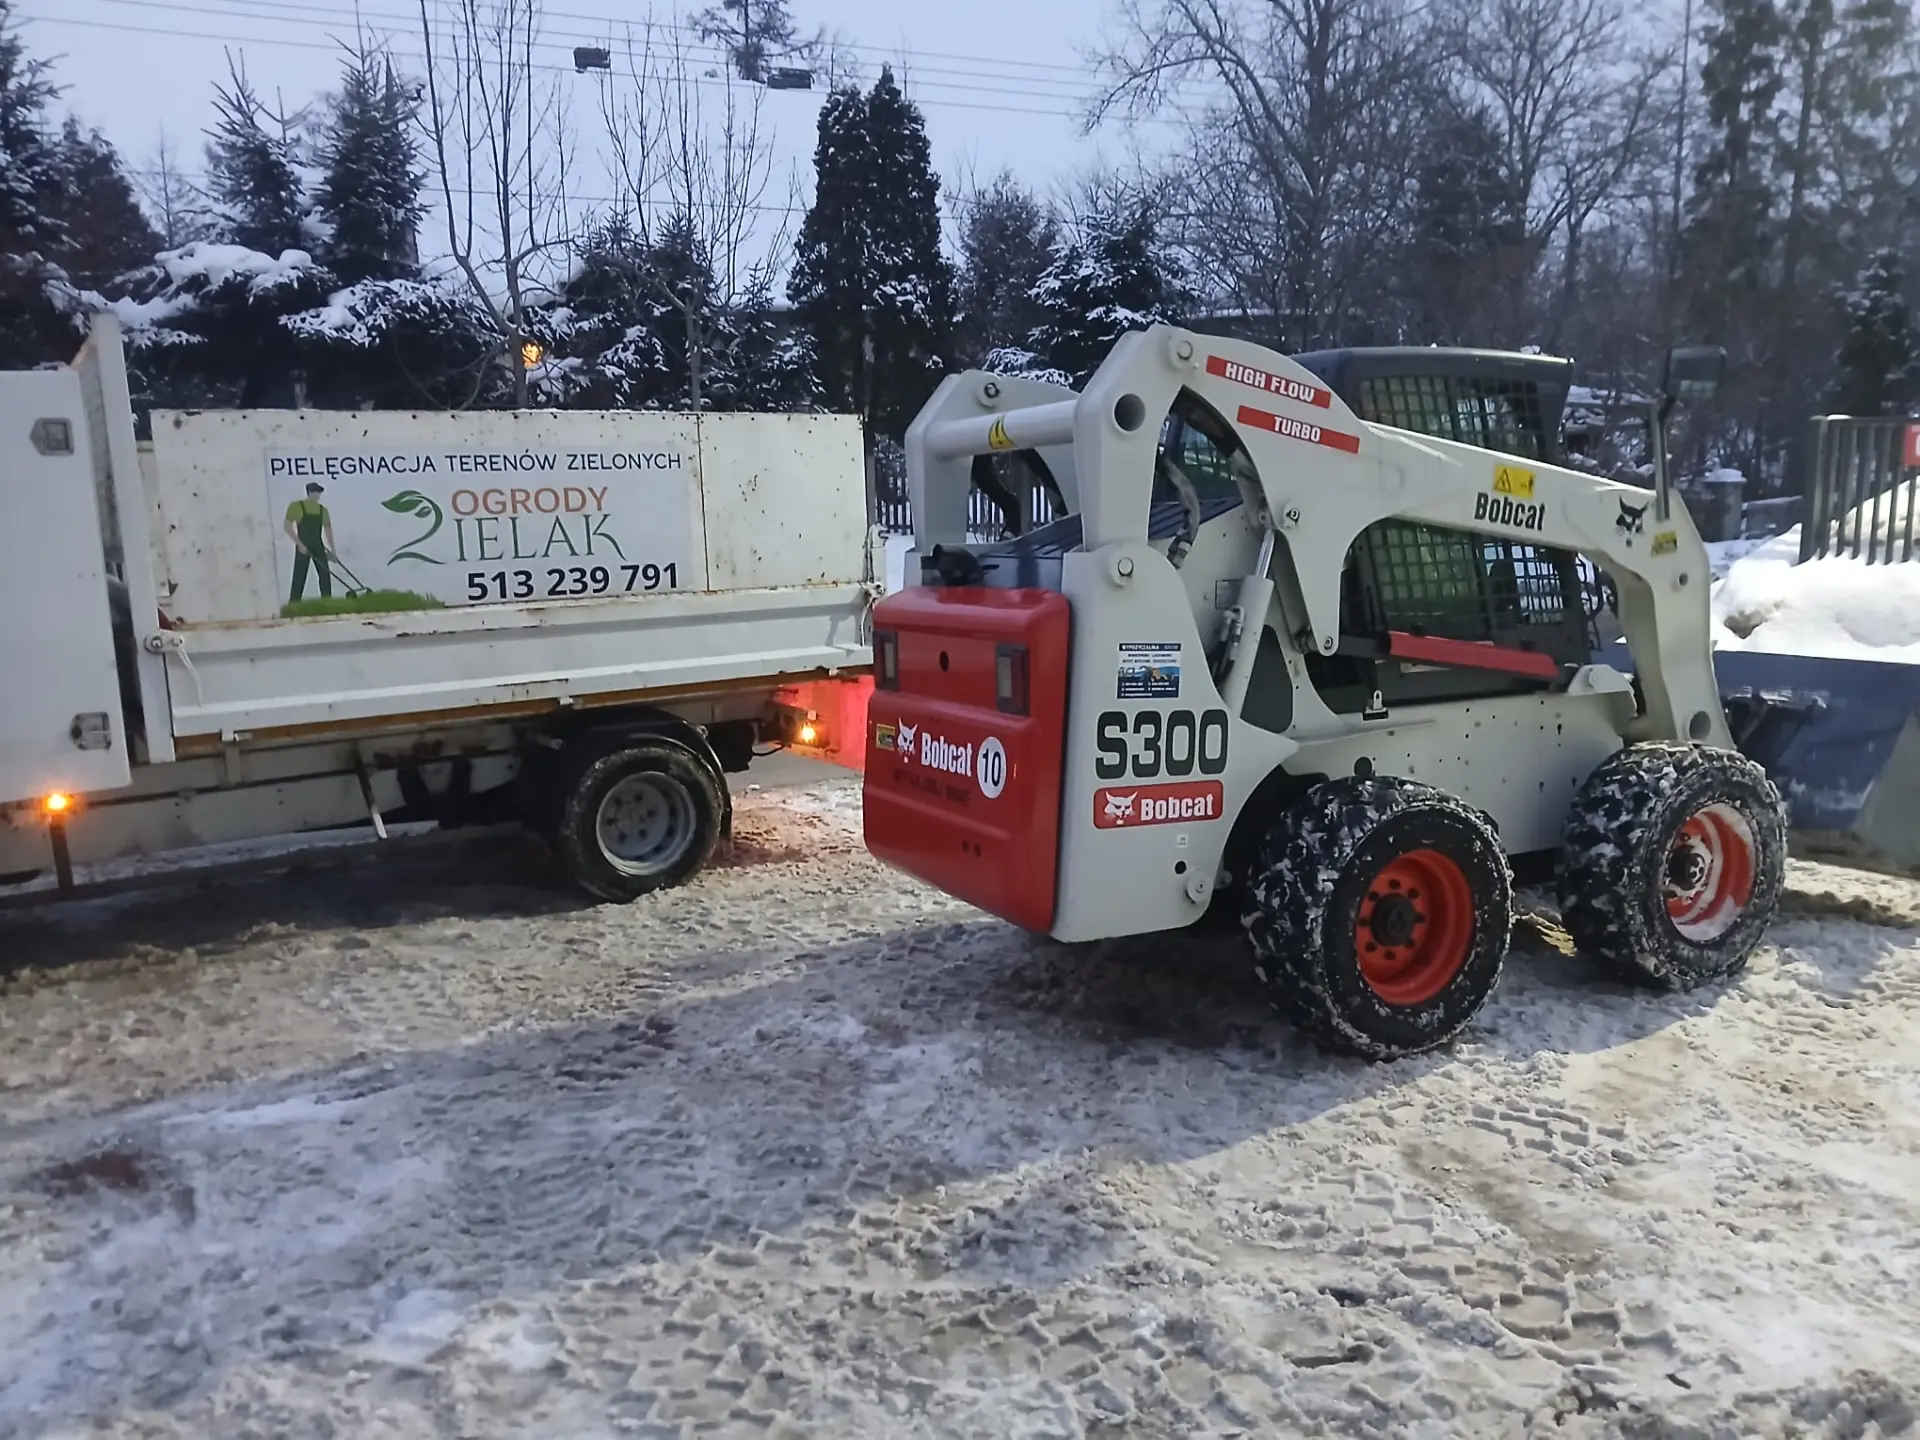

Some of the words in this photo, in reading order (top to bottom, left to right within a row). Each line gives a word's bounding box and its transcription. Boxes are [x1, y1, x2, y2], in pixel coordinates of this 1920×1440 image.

[1225, 361, 1266, 389] HIGH
[1270, 376, 1315, 403] FLOW
[1273, 416, 1322, 443] TURBO
[270, 454, 436, 480] PIELĘGNACJA
[445, 448, 557, 473] TERENÓW
[566, 452, 682, 472] ZIELONYCH
[451, 486, 609, 517] OGRODY
[1474, 492, 1546, 531] Bobcat
[467, 569, 534, 601] 513
[547, 565, 610, 597] 239
[620, 562, 678, 592] 791
[921, 732, 972, 777] Bobcat
[982, 748, 1001, 787] 10
[1095, 709, 1229, 780] S300
[1140, 793, 1214, 822] Bobcat
